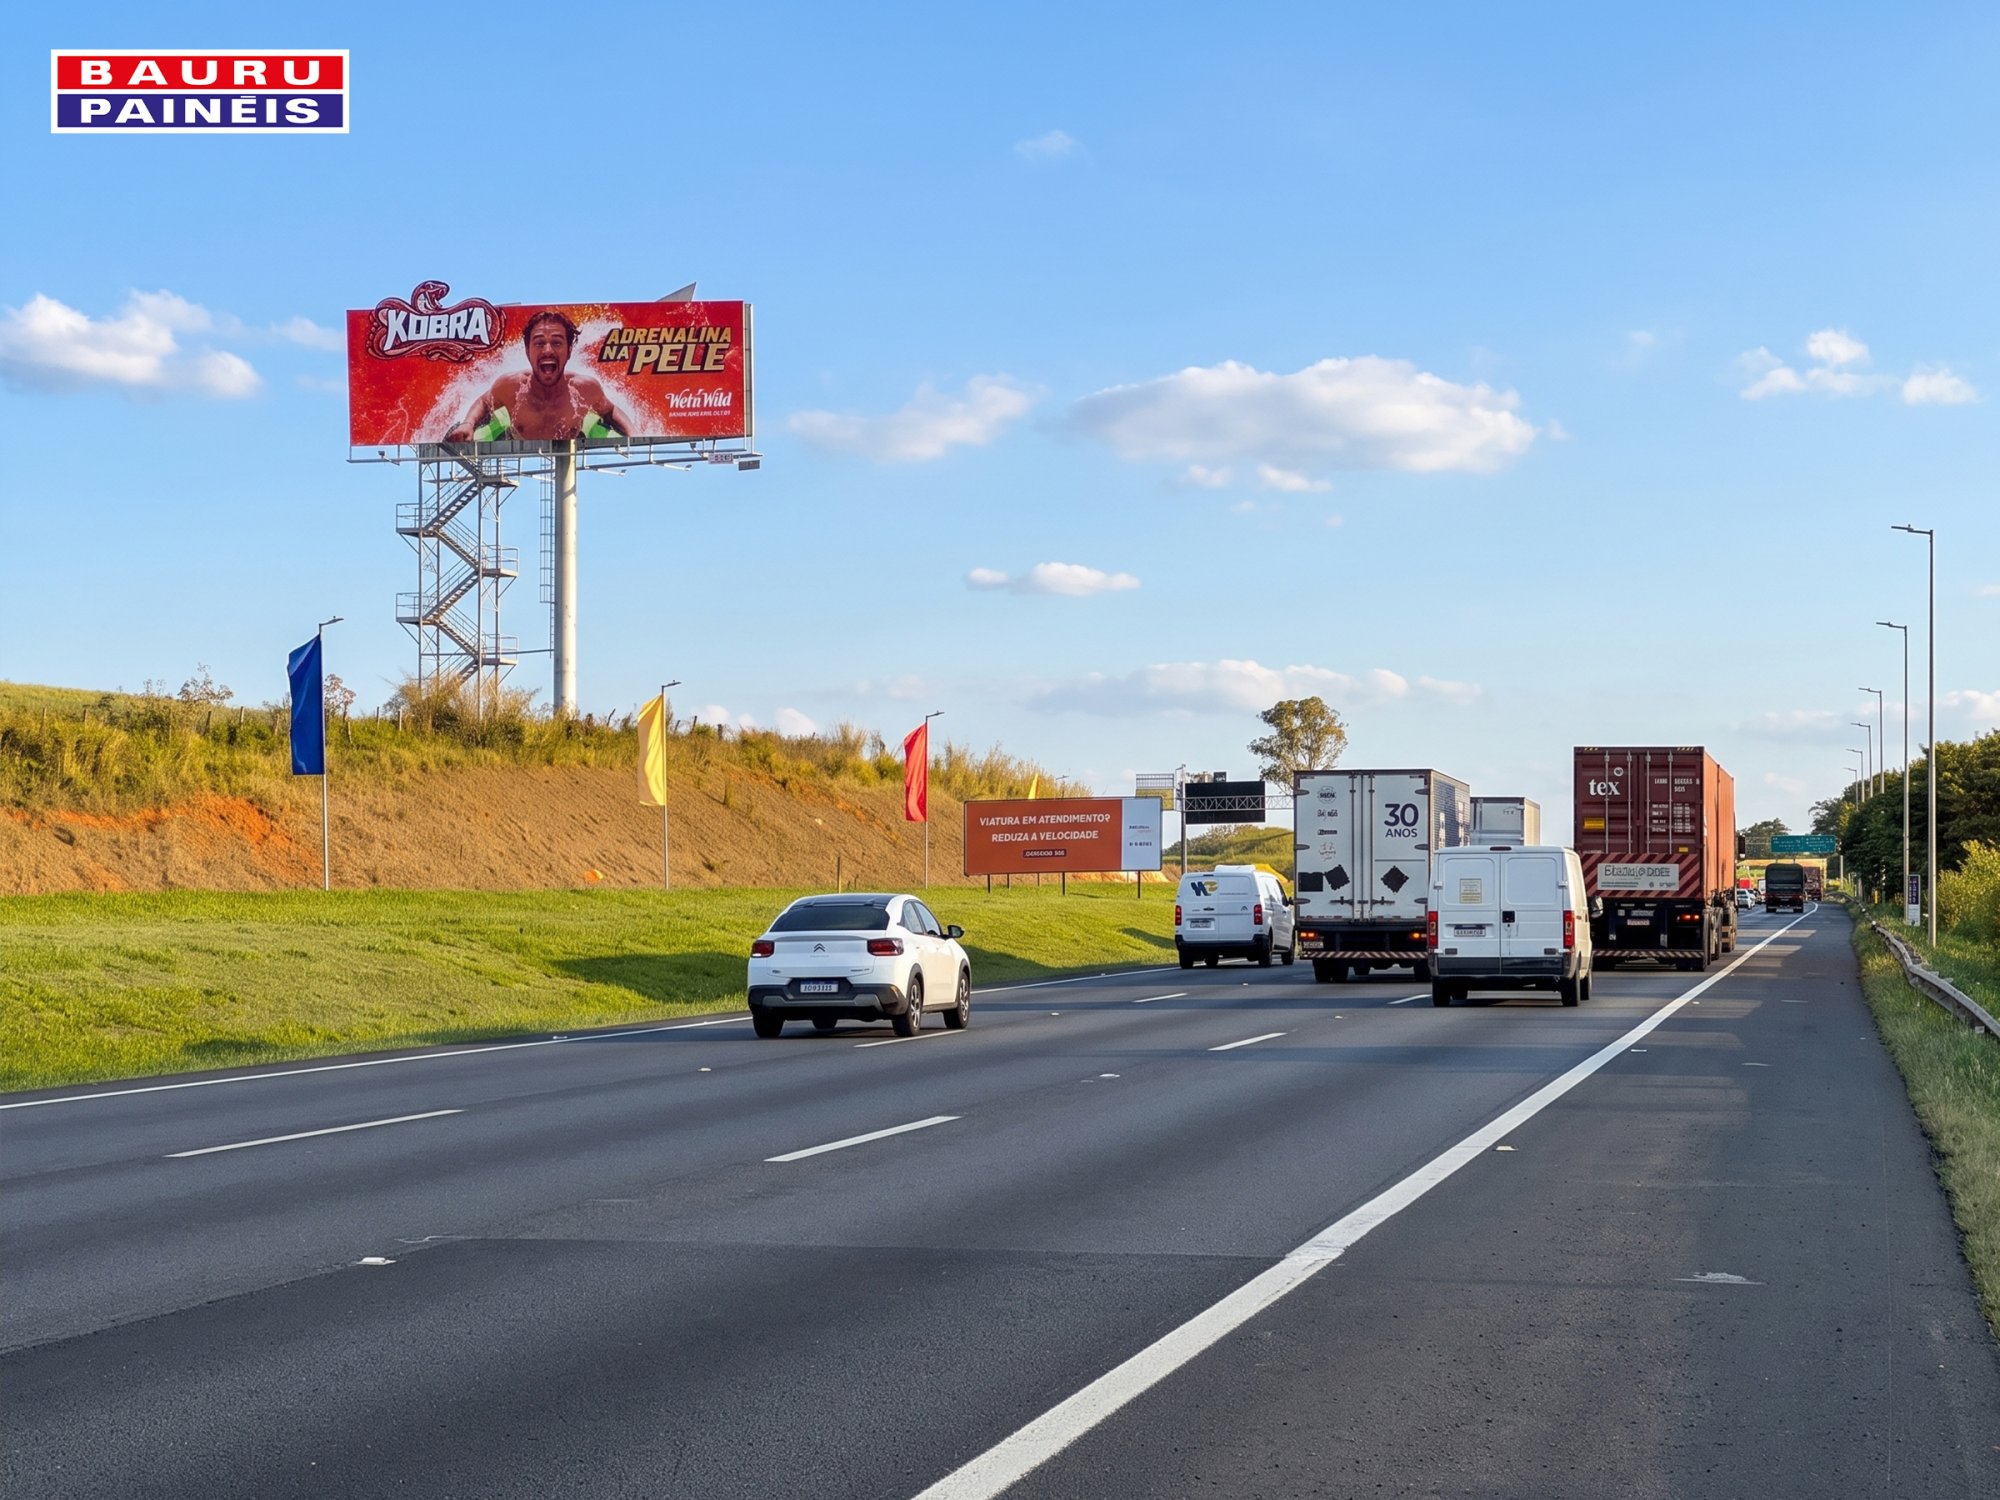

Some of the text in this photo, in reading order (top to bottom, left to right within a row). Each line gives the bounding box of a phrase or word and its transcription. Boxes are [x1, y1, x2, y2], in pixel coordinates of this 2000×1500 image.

[384, 307, 490, 351] KOBRA
[606, 327, 732, 344] ADRENALINA
[602, 343, 730, 373] NA PELE
[702, 388, 732, 408] Wild
[1588, 778, 1620, 796] tex
[979, 816, 1020, 826] VIATURA
[1022, 816, 1037, 825] EM
[1384, 803, 1419, 827] 30
[991, 830, 1099, 842] REDUZA A VELOCIDADE
[1385, 828, 1418, 838] ANOS
